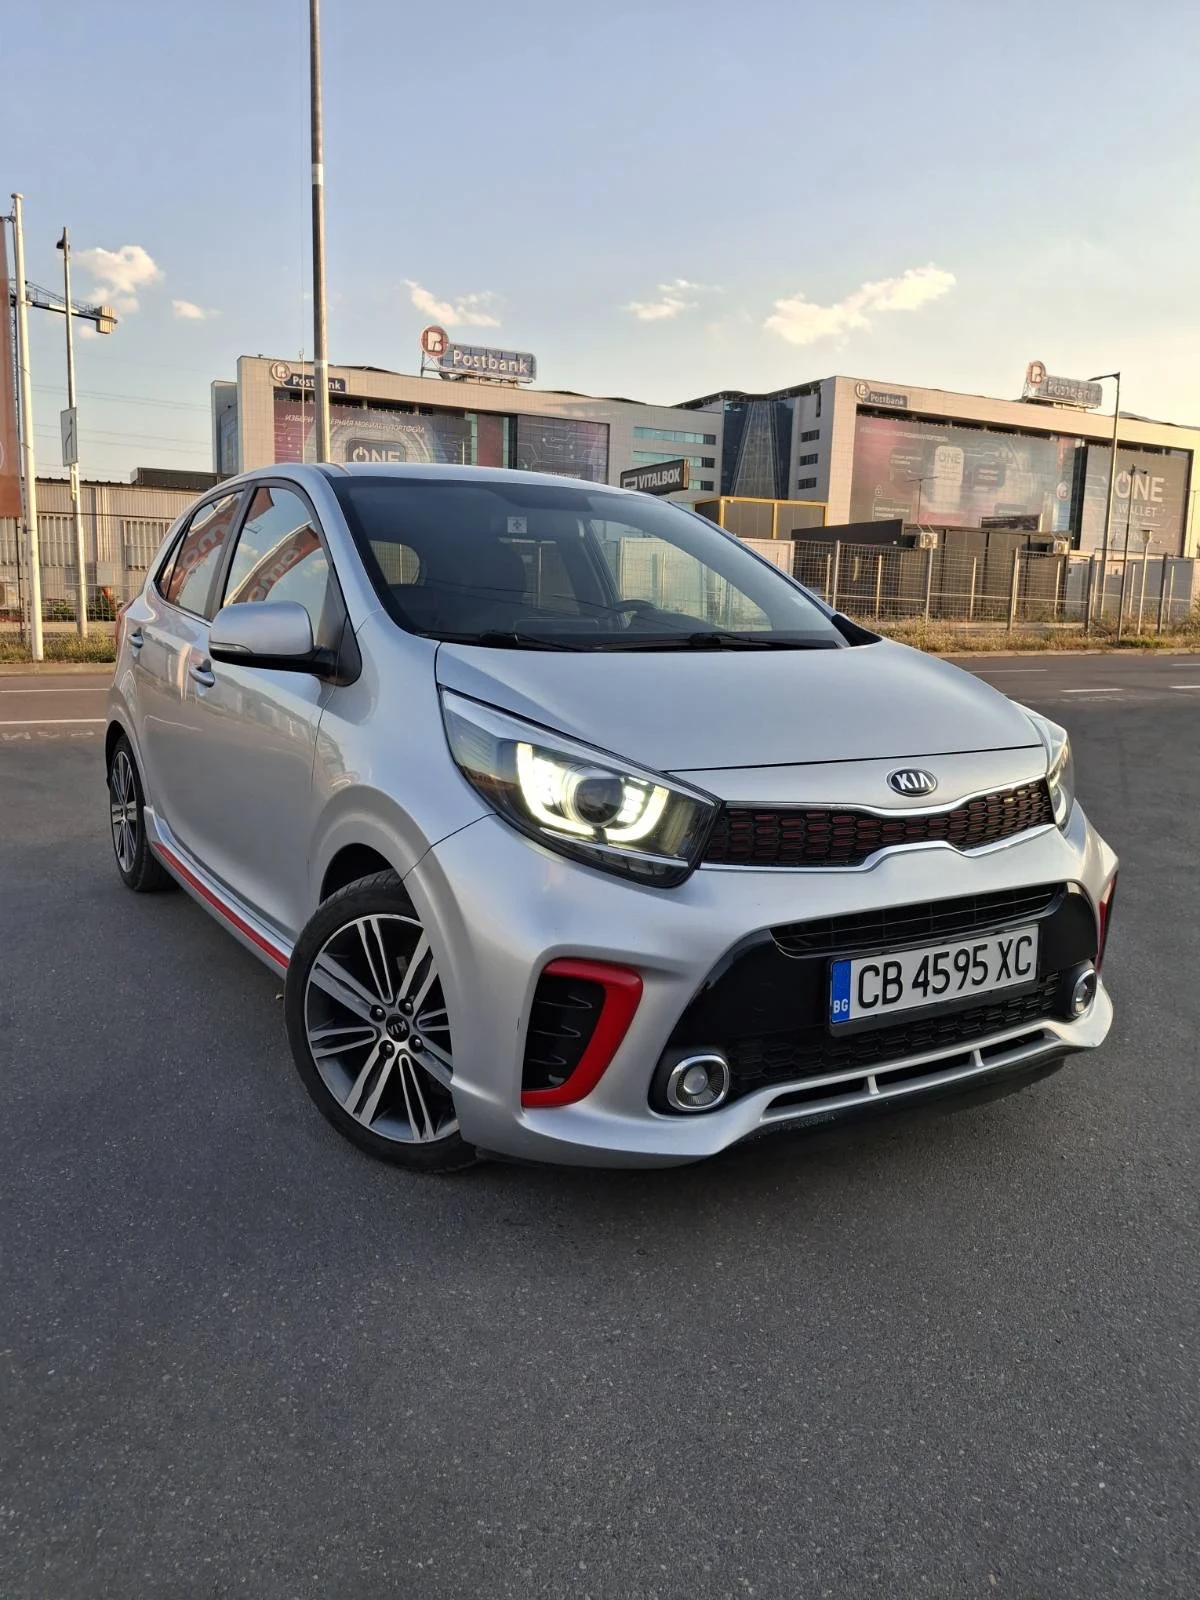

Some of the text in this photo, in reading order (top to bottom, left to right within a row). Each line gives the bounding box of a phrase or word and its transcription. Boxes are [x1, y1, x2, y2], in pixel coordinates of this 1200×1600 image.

[453, 349, 528, 373] Postbank
[293, 375, 341, 390] Postnk
[870, 392, 905, 406] Postbank
[938, 450, 962, 465] ONE
[638, 467, 680, 489] VITALBOX
[1115, 470, 1164, 503] ONE
[896, 774, 933, 791] KIA
[857, 935, 1032, 1010] CB 4595 XC
[833, 999, 849, 1014] BG
